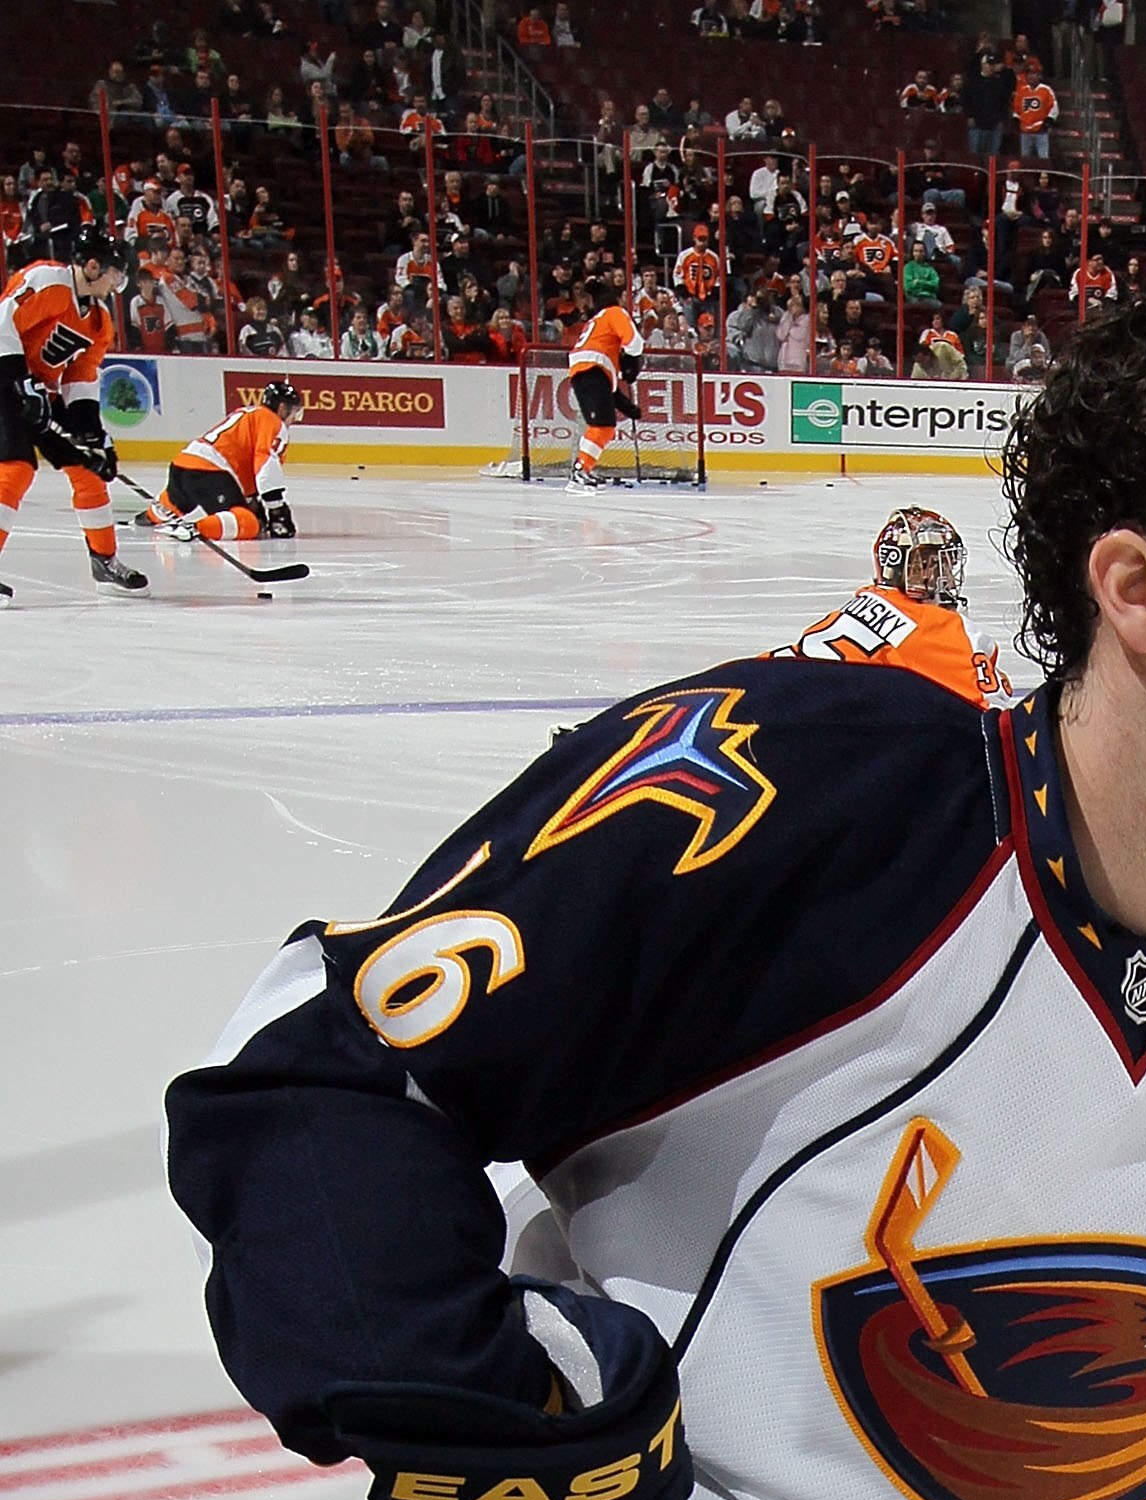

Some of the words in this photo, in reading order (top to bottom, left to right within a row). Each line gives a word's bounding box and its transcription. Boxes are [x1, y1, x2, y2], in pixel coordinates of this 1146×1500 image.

[236, 387, 336, 411] WLS
[341, 391, 434, 413] FARGO
[793, 398, 1014, 438] enterpris
[665, 430, 765, 444] GOODS
